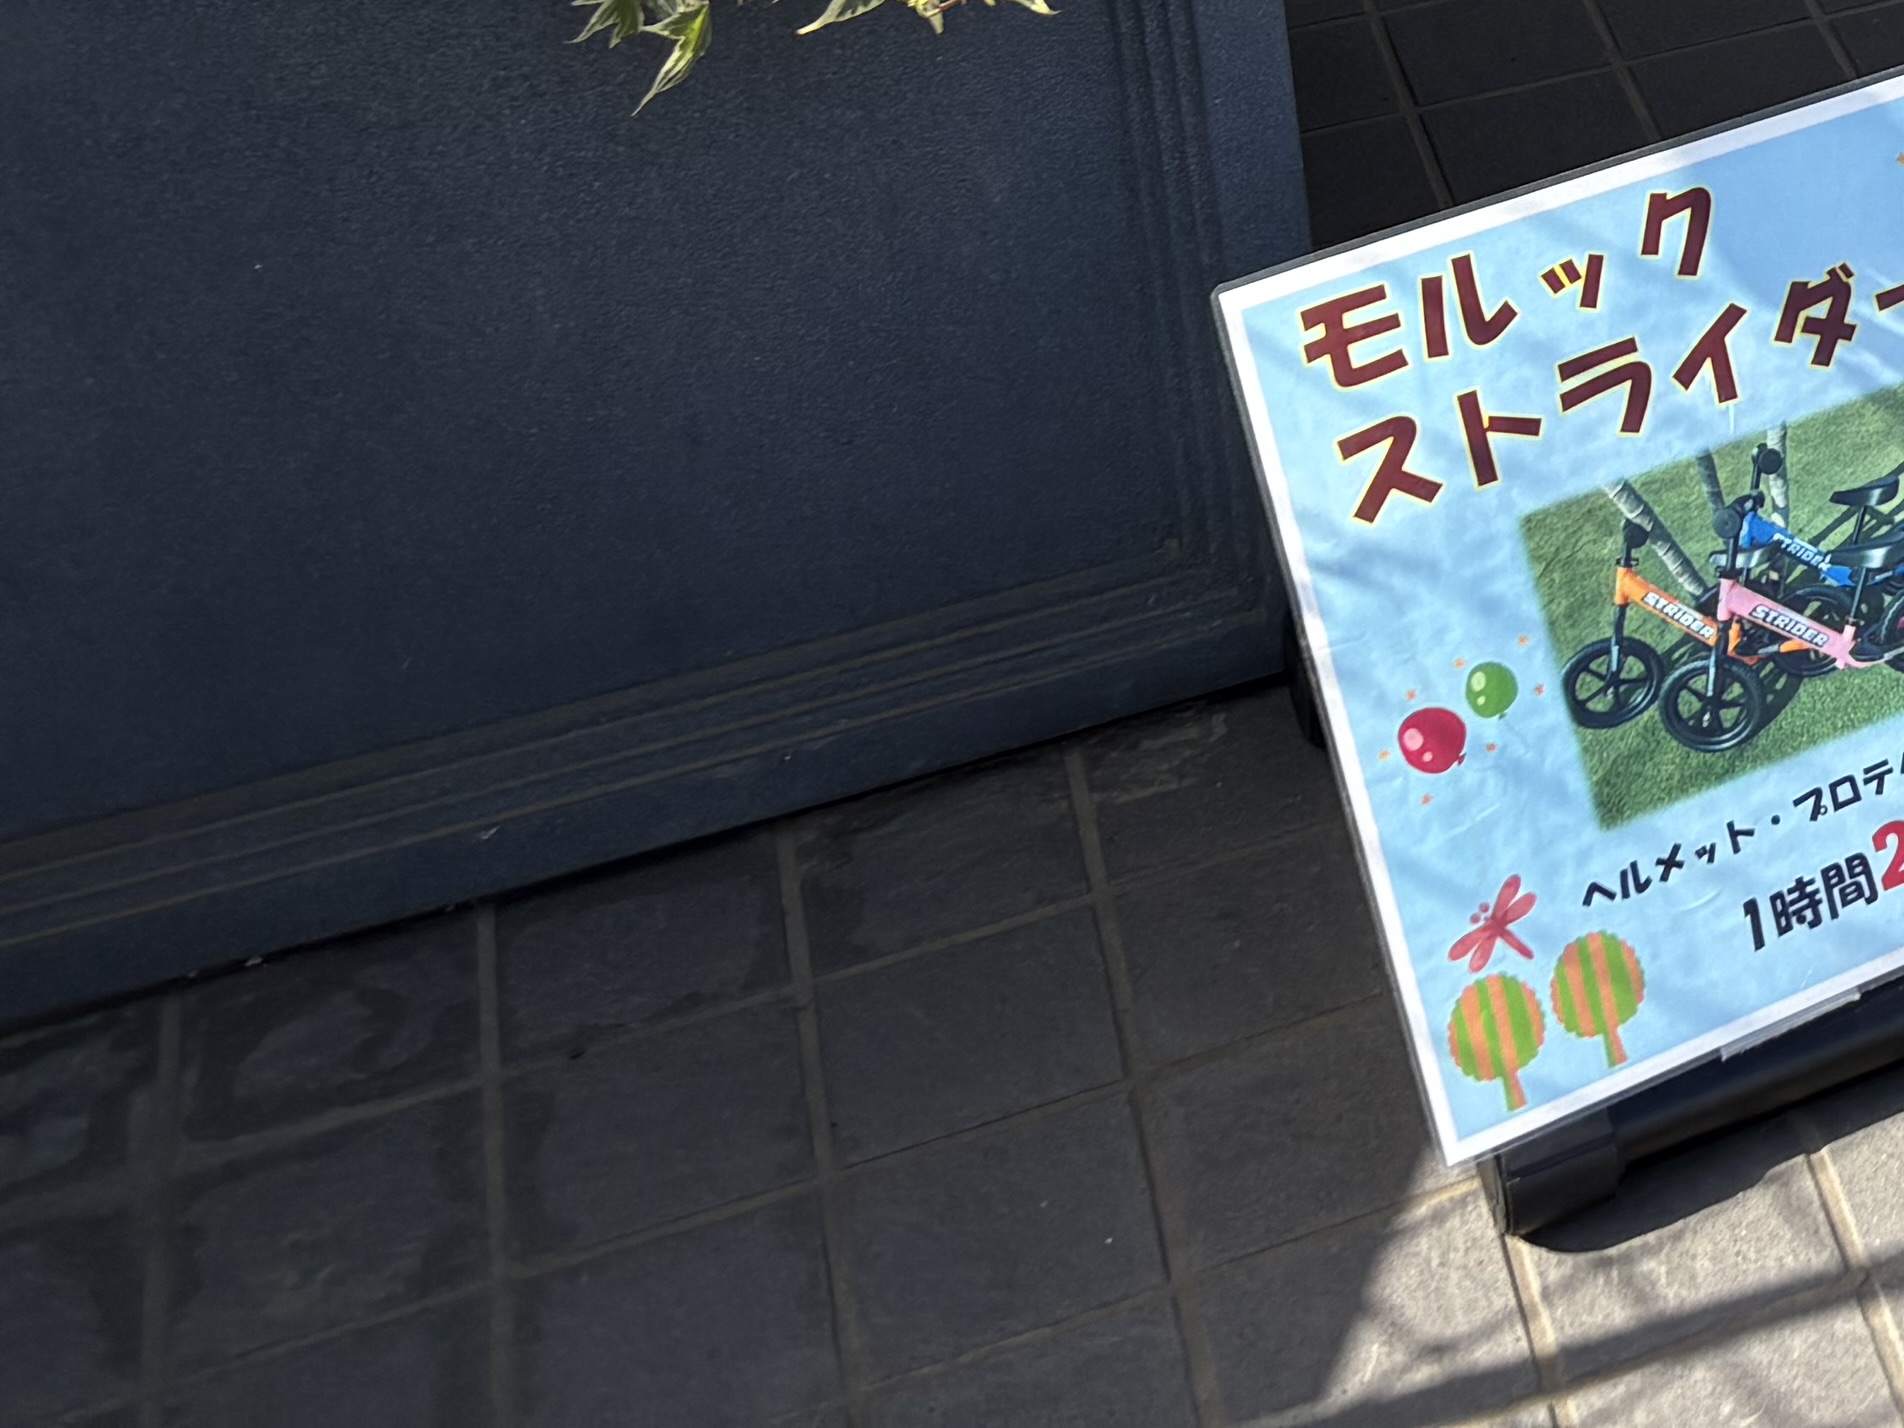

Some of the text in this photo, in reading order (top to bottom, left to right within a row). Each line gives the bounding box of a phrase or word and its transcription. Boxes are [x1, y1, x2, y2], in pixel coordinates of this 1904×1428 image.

[1298, 185, 1714, 389] モルック
[1641, 591, 1717, 641] STRIDER
[1750, 604, 1831, 648] STRIDER
